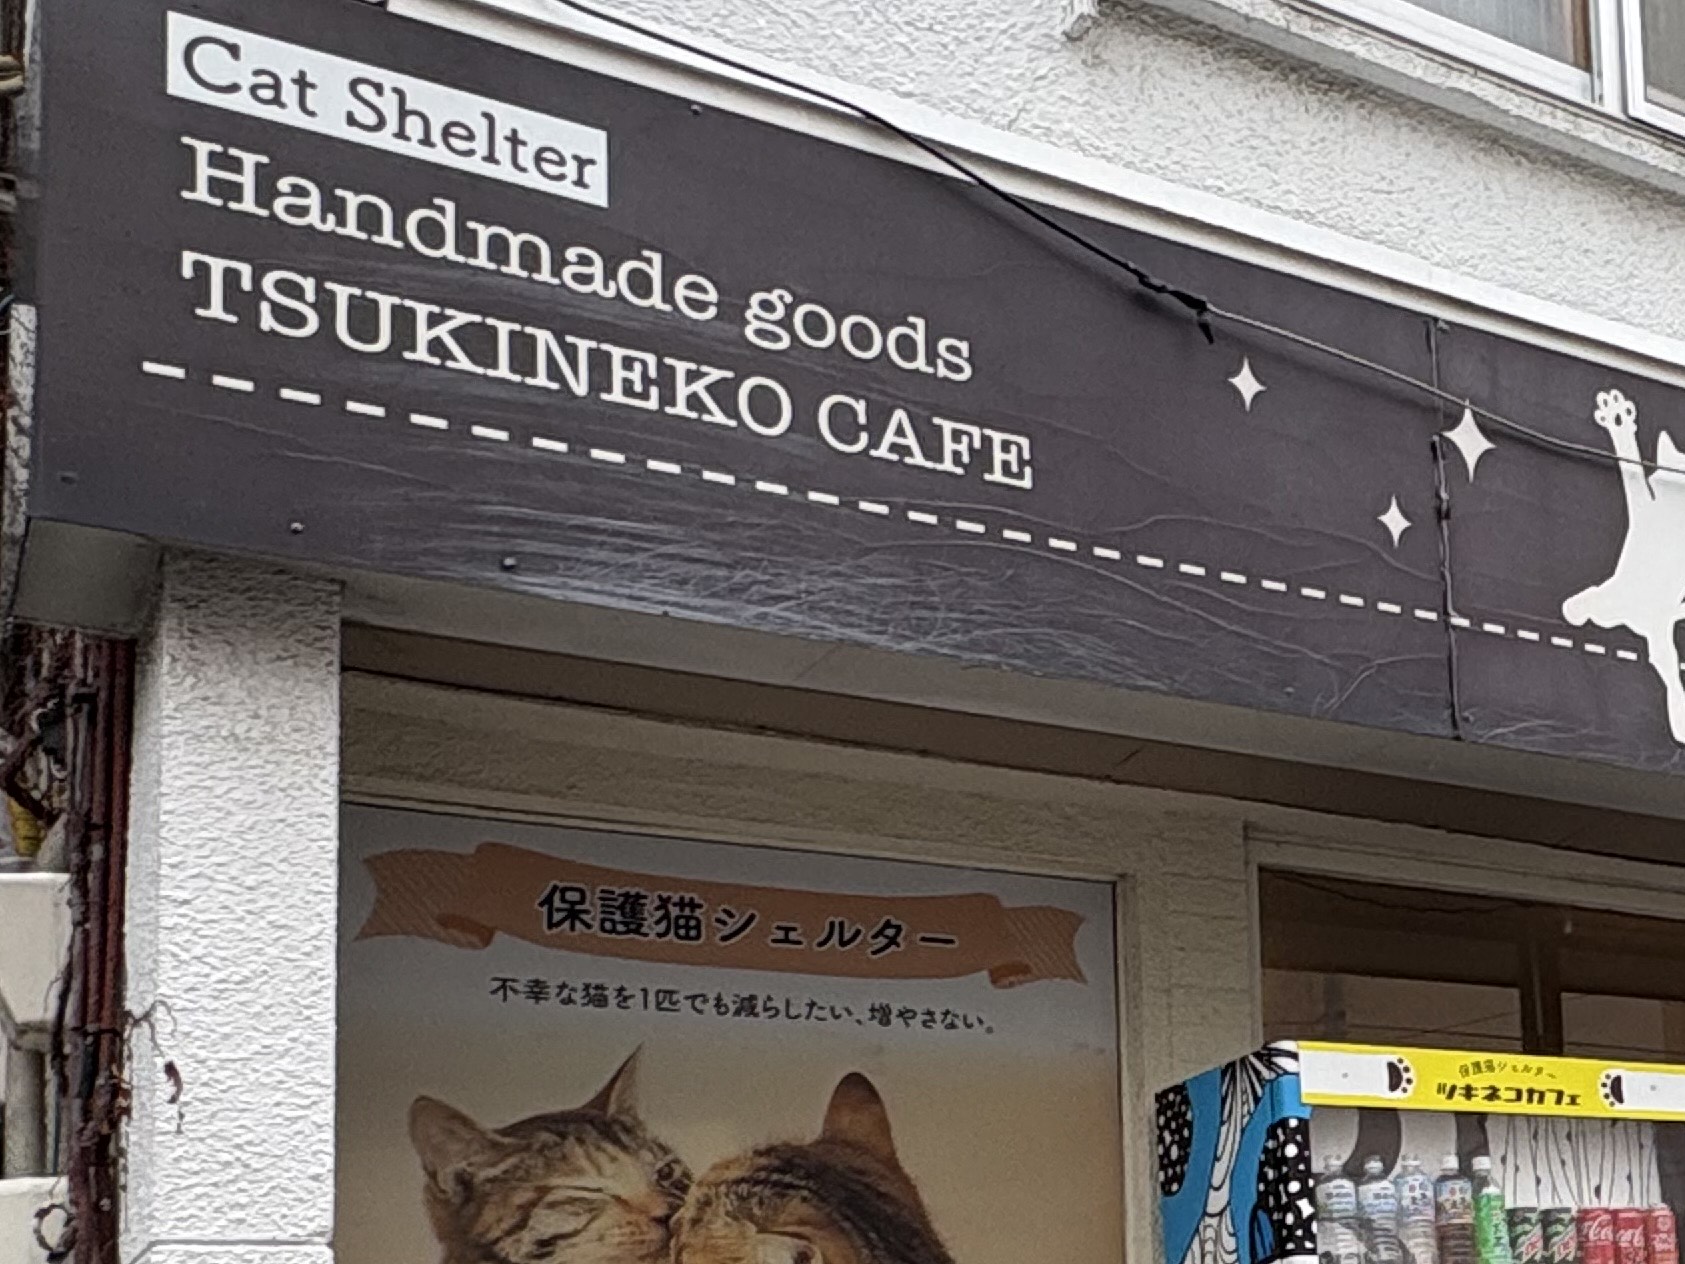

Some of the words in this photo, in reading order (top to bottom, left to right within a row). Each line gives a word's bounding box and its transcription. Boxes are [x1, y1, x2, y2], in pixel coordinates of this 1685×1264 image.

[180, 34, 318, 117] Cat
[345, 74, 599, 190] Shelter
[180, 135, 720, 322] Handmade
[743, 283, 974, 382] goods
[180, 249, 793, 439] TSUKINEKO
[817, 393, 1035, 490] CAFE
[537, 881, 960, 957] 保護猫シェルター
[489, 975, 996, 1036] 不幸な猫を1匹でも減らしたい、増やさない。
[1436, 1082, 1581, 1106] ツキネコカフェ
